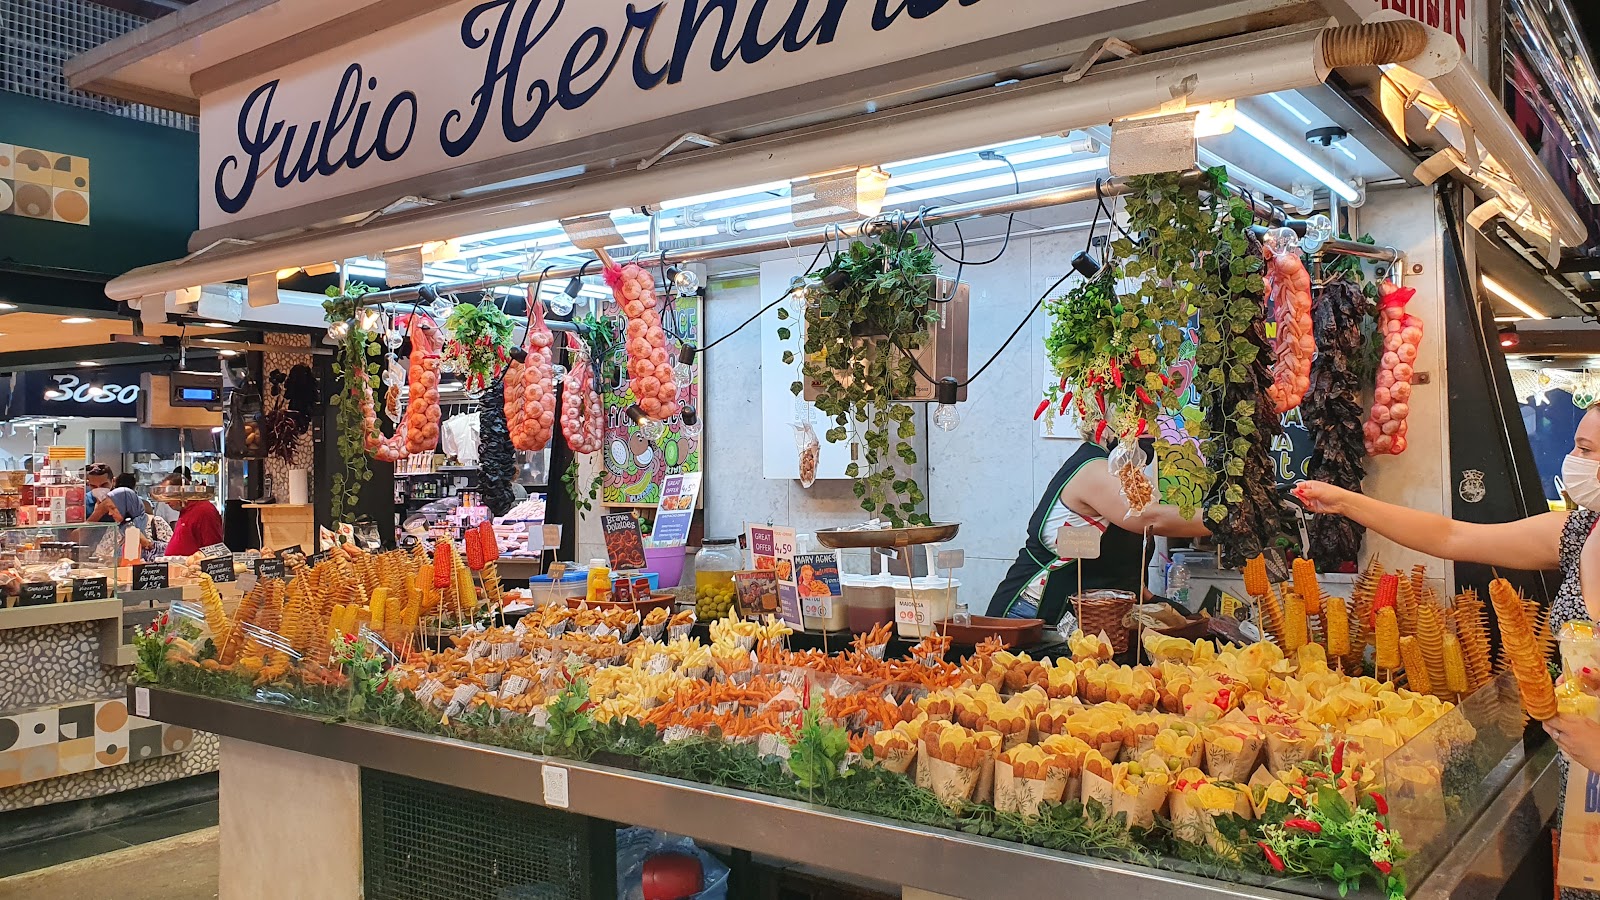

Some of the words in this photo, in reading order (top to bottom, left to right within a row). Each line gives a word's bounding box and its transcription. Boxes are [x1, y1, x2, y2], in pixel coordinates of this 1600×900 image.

[214, 62, 418, 214] Julio
[605, 514, 630, 525] Brave
[754, 532, 772, 542] GREAT
[755, 543, 772, 552] OFFER
[774, 543, 792, 555] 4,50
[794, 556, 814, 565] MARY
[815, 554, 837, 564] AGNES
